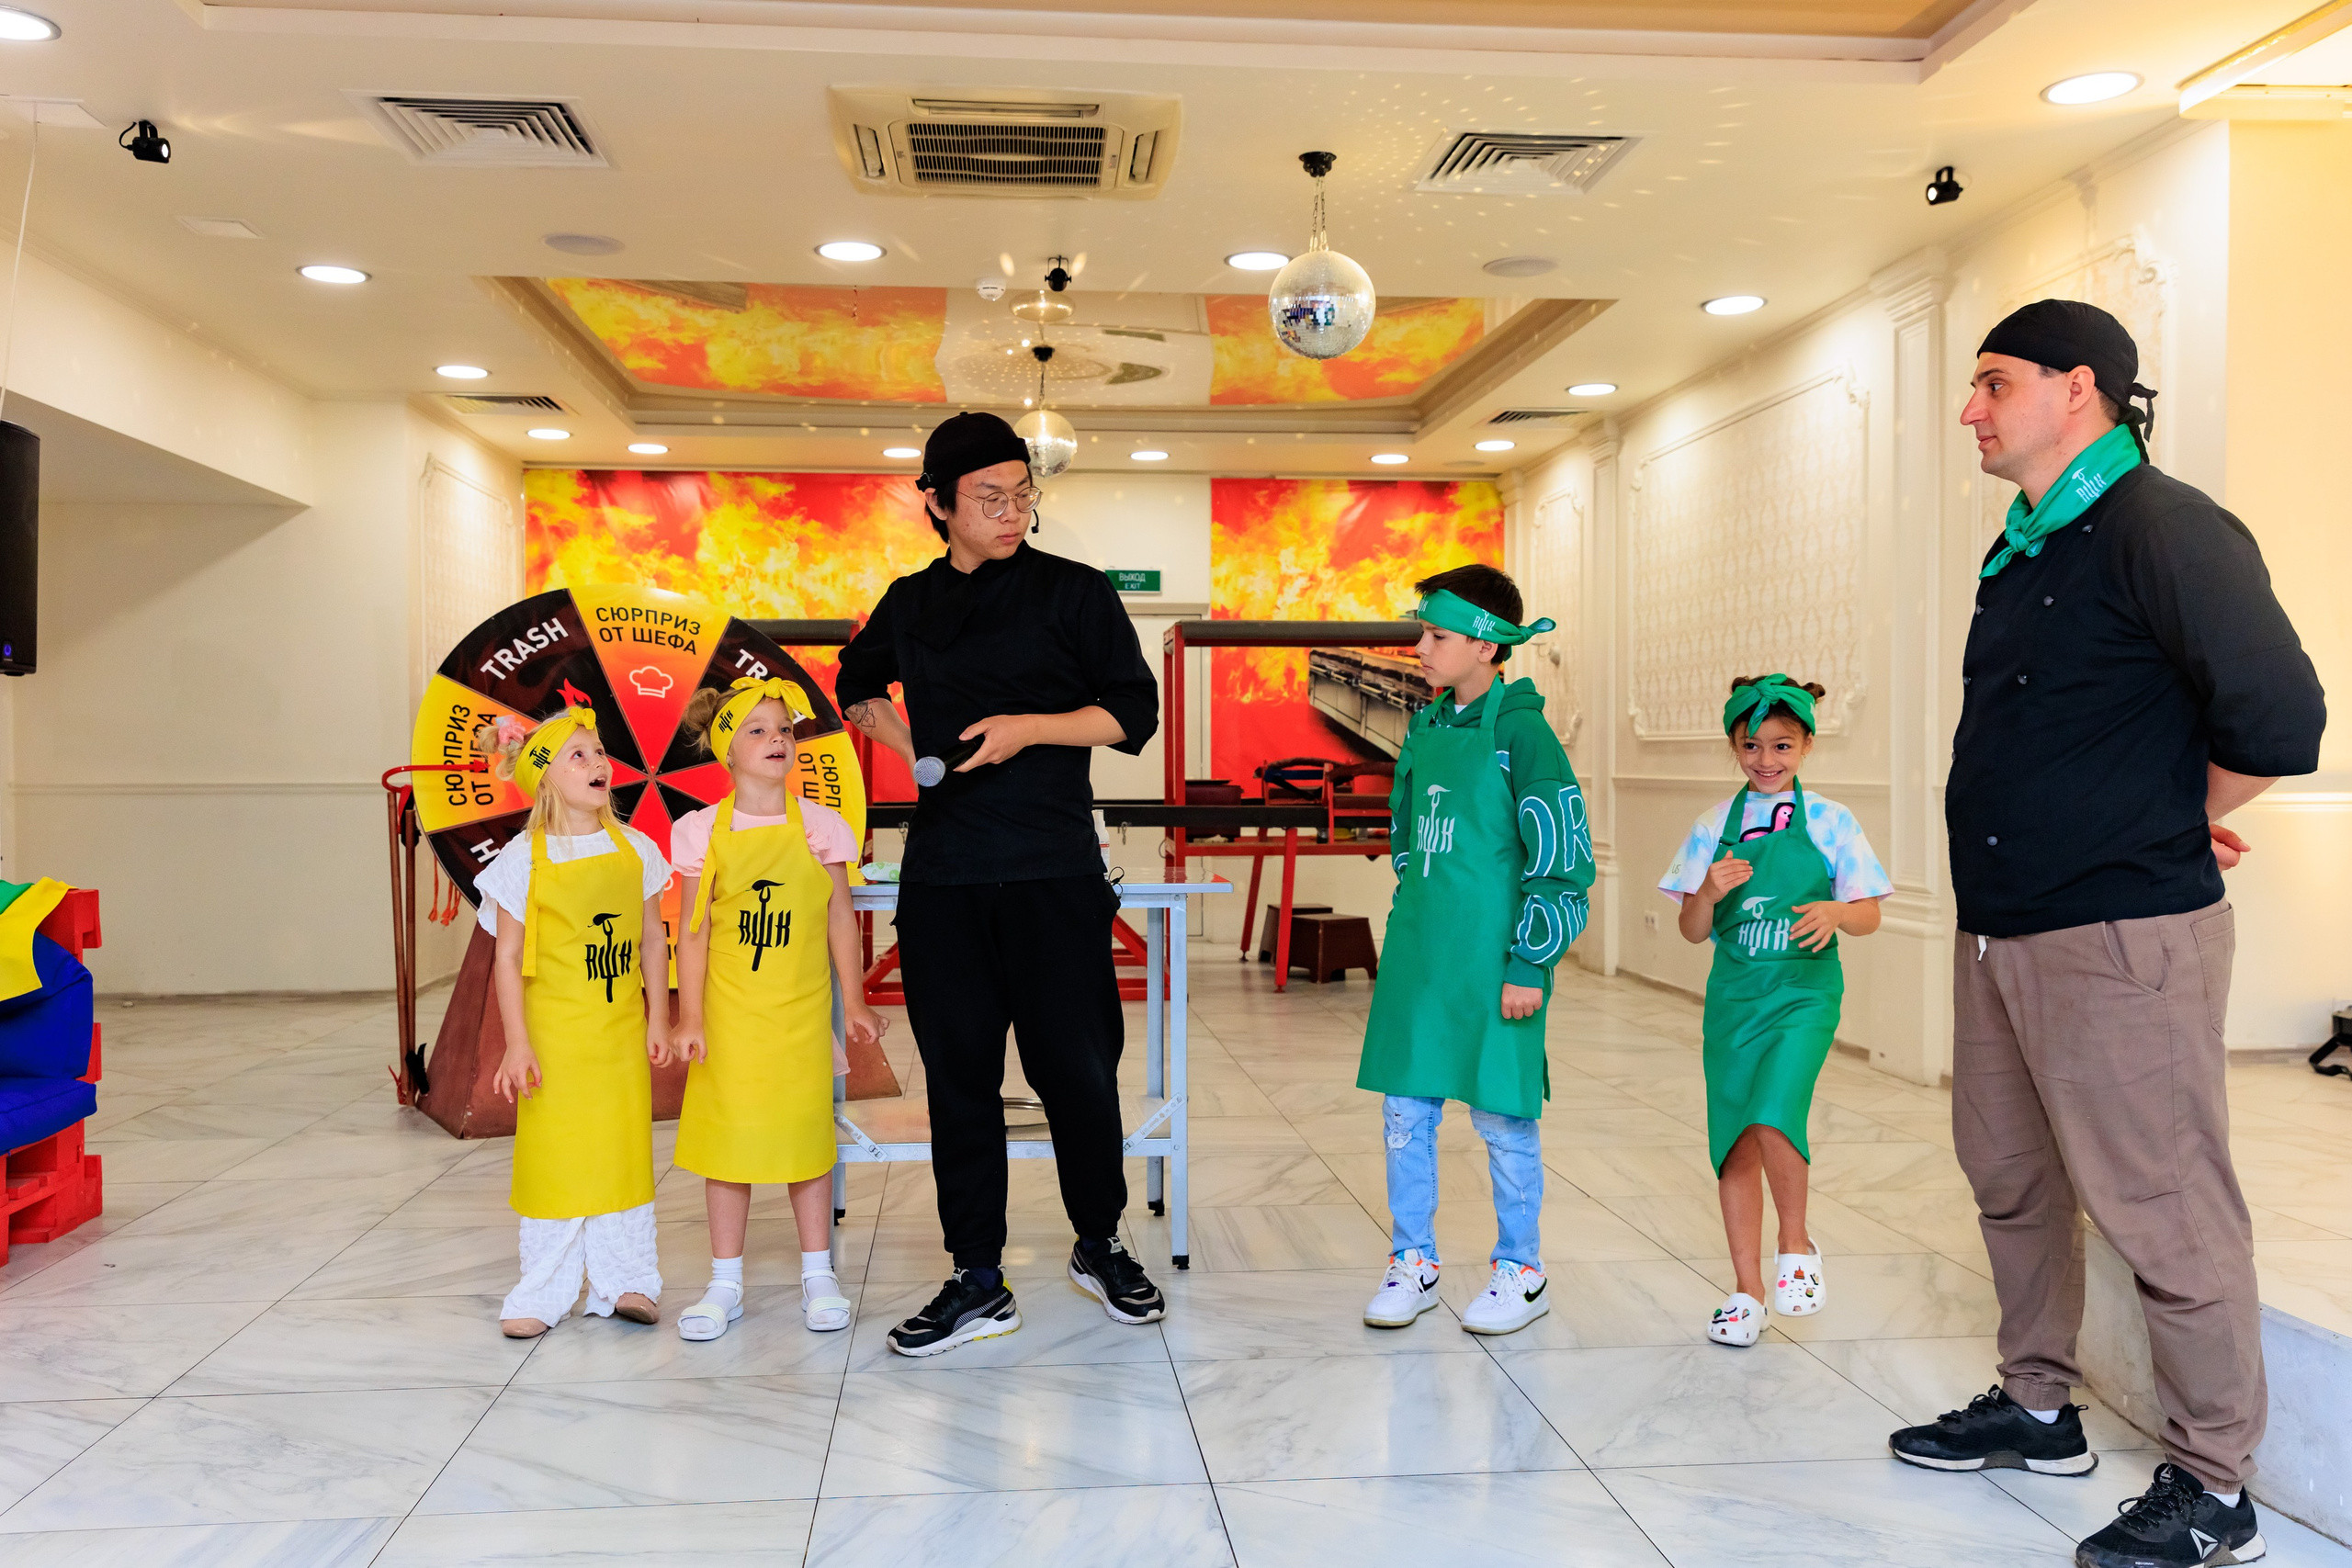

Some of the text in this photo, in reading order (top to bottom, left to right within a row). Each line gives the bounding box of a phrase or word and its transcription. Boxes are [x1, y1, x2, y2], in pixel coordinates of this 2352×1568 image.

[1118, 572, 1146, 582] ВЫХОД
[596, 606, 701, 636] СЮРПРИЗ
[480, 617, 569, 681] TRASH
[599, 626, 697, 655] ОТ ШЕФА
[797, 752, 818, 775] ОТ
[471, 781, 494, 806] ОТ
